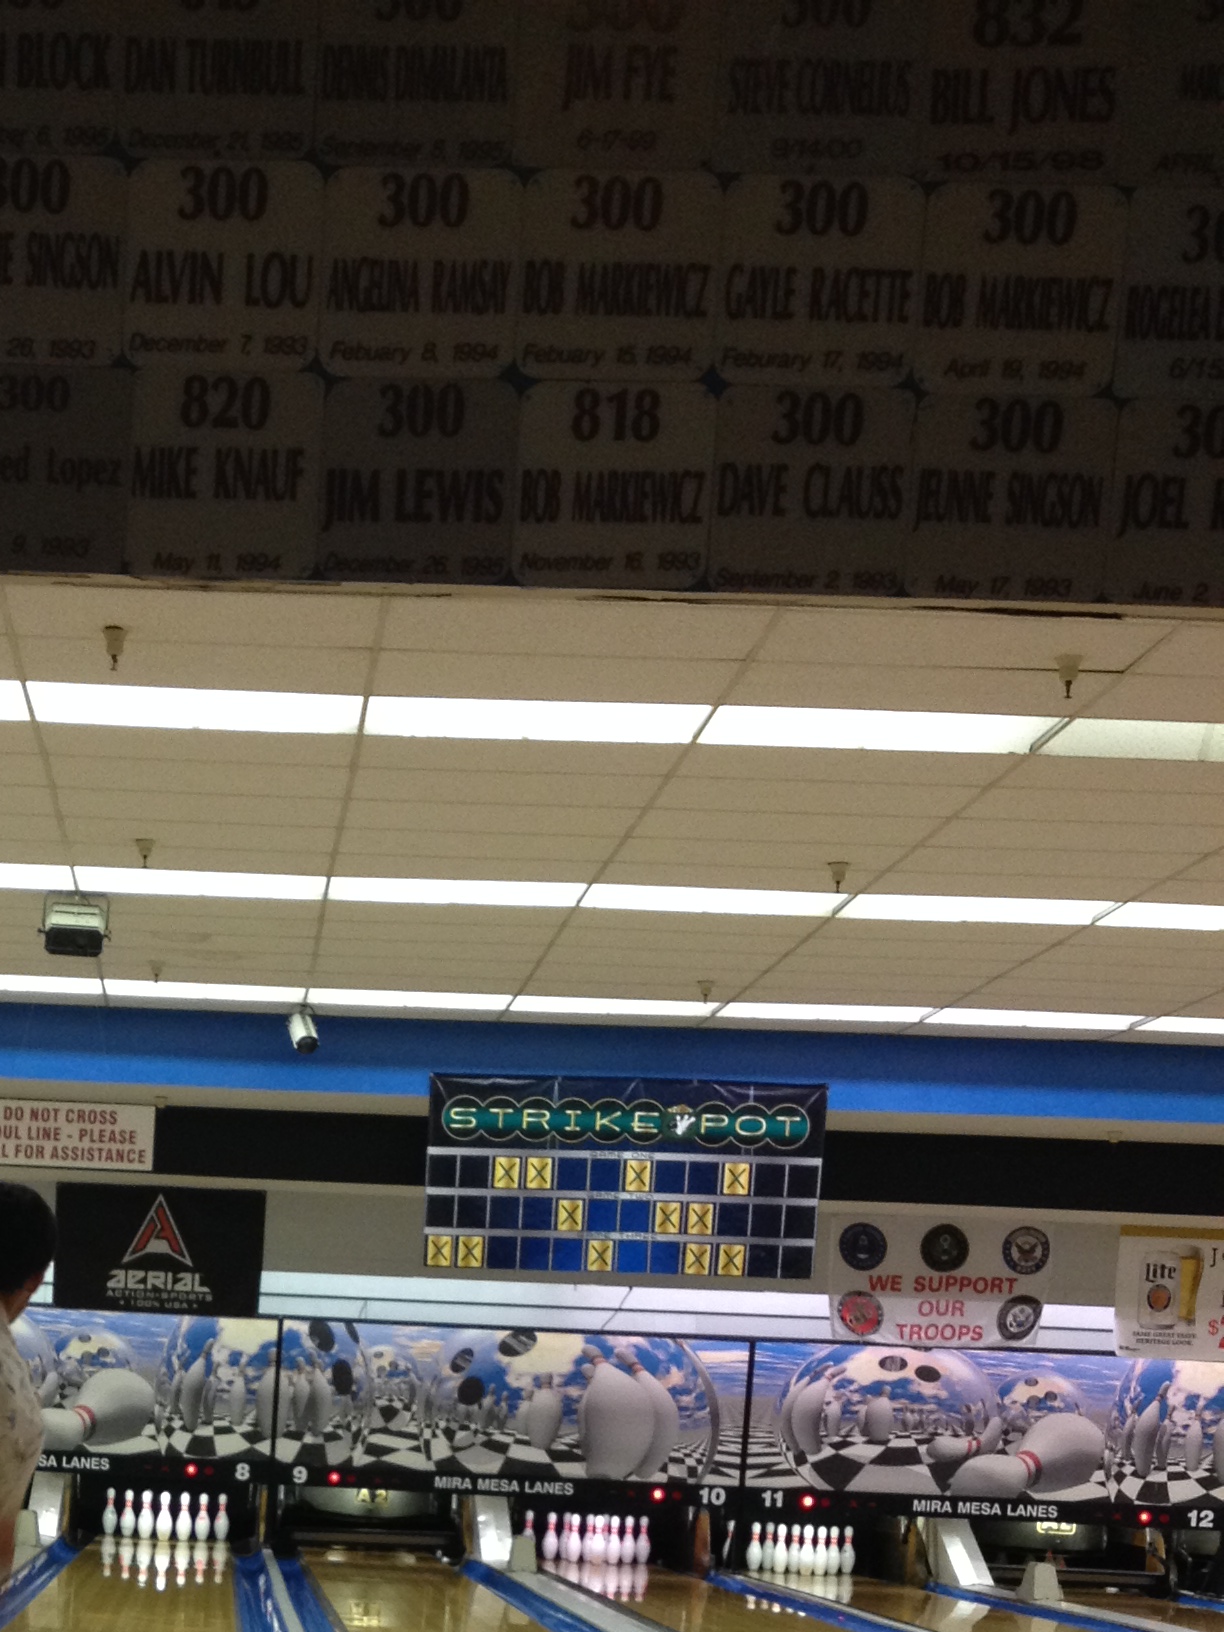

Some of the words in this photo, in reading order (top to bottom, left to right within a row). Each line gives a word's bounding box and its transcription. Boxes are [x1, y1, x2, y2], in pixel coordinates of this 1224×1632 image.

[972, 0, 1083, 47] 832
[16, 32, 112, 91] BLOCK
[125, 36, 176, 95] DAN
[185, 38, 306, 96] TURNBULL
[624, 44, 680, 104] FYE
[727, 57, 792, 116] STEVE
[930, 68, 995, 125] BILL
[1007, 66, 1118, 136] JONES
[936, 149, 1105, 173] 10/15/98
[177, 165, 269, 221] 300
[377, 172, 470, 228] 300
[570, 174, 664, 231] 300
[773, 179, 869, 236] 300
[982, 189, 1078, 246] 300
[130, 249, 224, 306] ALVIN
[245, 251, 314, 309] LOU
[326, 256, 420, 314] ANGELINA
[431, 258, 513, 316] RAMSAY
[522, 259, 566, 316] BOB
[575, 262, 712, 319] MARKIEWICZ
[724, 262, 798, 321] GAYLE
[808, 266, 915, 324] RACETTE
[922, 272, 968, 330] BOB
[49, 338, 98, 361] 1993
[129, 332, 229, 355] December
[453, 342, 500, 364] 1994
[646, 344, 694, 366] 1994
[856, 350, 905, 372] 1994
[943, 358, 991, 379] April
[1037, 359, 1088, 380] 1994
[180, 374, 272, 430] 820
[377, 382, 466, 438] 300
[571, 387, 662, 442] 818
[771, 389, 865, 447] 300
[969, 397, 1065, 454] 300
[45, 450, 124, 493] Lopez
[130, 445, 200, 500] MIKE
[212, 446, 307, 502] KNAUF
[717, 461, 790, 519] DAVE
[802, 461, 905, 522] CLAUSS
[321, 468, 381, 532] JIM
[394, 468, 506, 525] LEWIS
[519, 468, 562, 525] BOB
[572, 469, 707, 525] MARKIEWICZ
[1117, 471, 1191, 540] JOEL
[519, 551, 613, 574] November
[935, 574, 976, 600] May
[1023, 577, 1073, 599] 1993
[1132, 580, 1184, 604] June
[3, 1105, 25, 1122] DO
[30, 1107, 60, 1123] NOT
[65, 1108, 118, 1125] CROSS
[27, 1125, 62, 1142] LINE
[78, 1127, 137, 1146] PLEASE
[448, 1105, 661, 1134] STRIKE
[699, 1112, 803, 1138] POT
[14, 1143, 45, 1160] FOR
[50, 1145, 147, 1165] ASSISTANCE
[868, 1274, 903, 1292] WE
[913, 1275, 1019, 1294] SUPPORT
[1144, 1262, 1177, 1283] Lite
[917, 1299, 966, 1318] OUR
[894, 1323, 984, 1342] TROOPS
[62, 1455, 111, 1471] LANES
[234, 1462, 251, 1482] 8
[292, 1465, 309, 1485] 9
[434, 1475, 474, 1492] MIRA
[476, 1477, 520, 1494] MESA
[524, 1479, 576, 1497] LANES
[698, 1486, 727, 1507] 10
[761, 1489, 785, 1510] 11
[912, 1498, 953, 1515] MIRA
[957, 1500, 1002, 1517] MESA
[1005, 1503, 1059, 1520] LANES
[1187, 1509, 1216, 1529] 12
